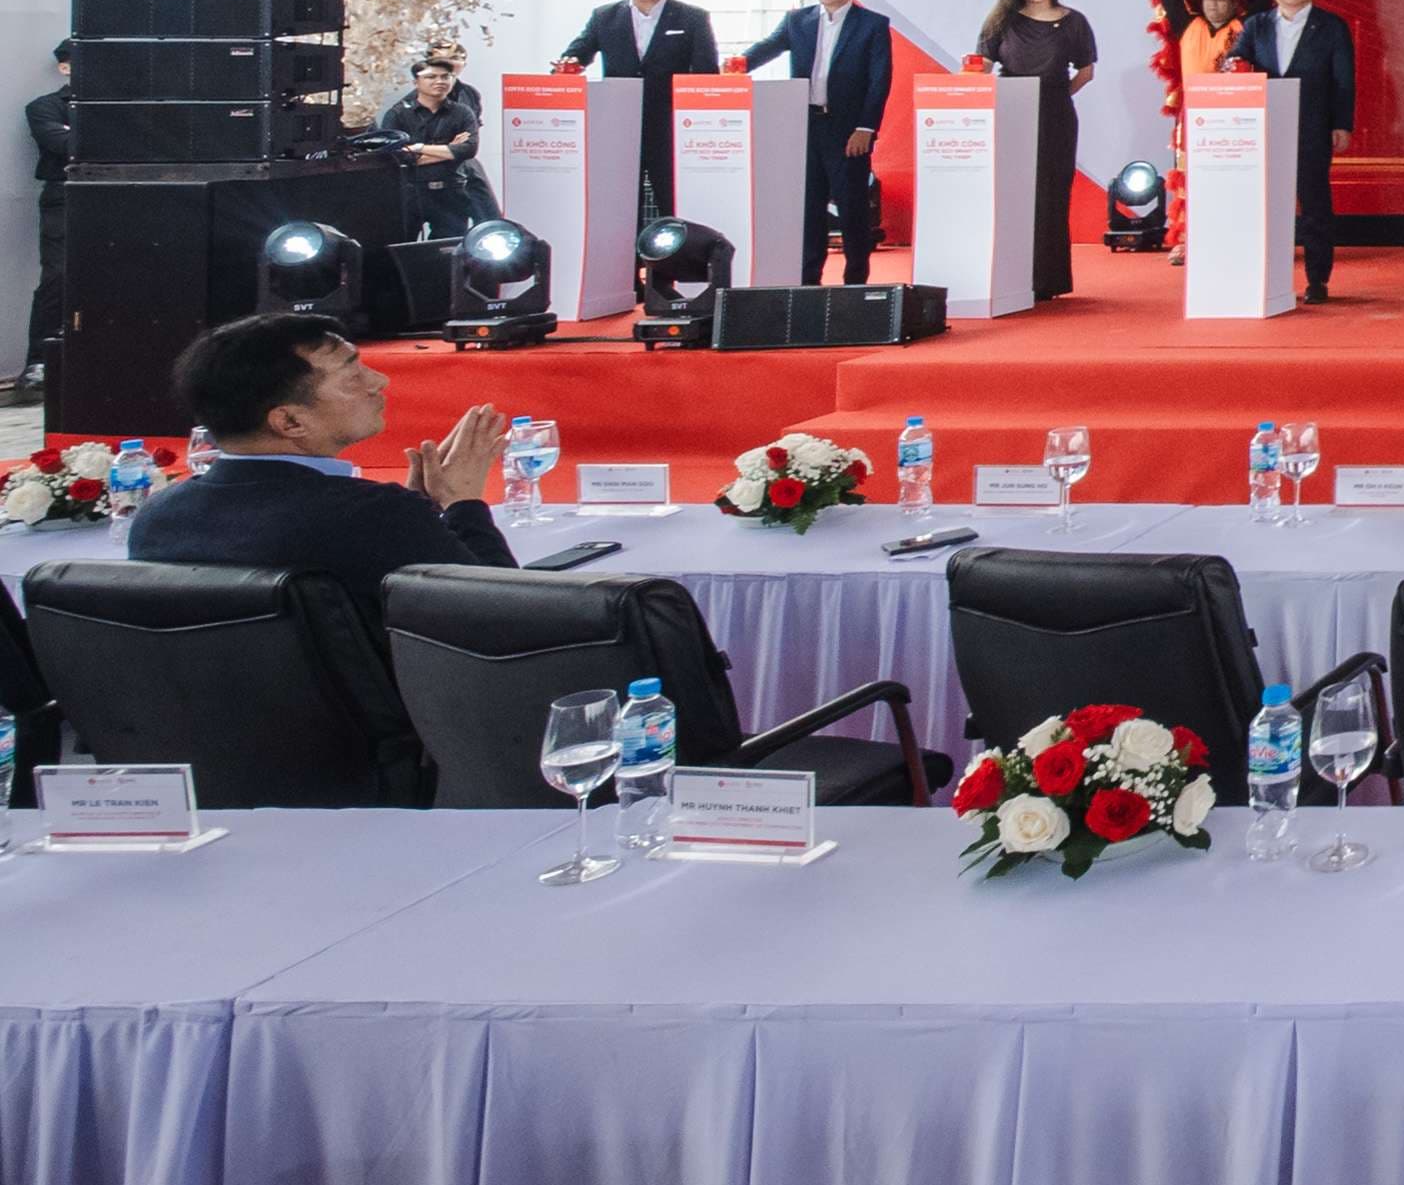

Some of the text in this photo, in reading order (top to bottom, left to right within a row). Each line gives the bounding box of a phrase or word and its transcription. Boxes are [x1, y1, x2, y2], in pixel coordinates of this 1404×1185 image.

[293, 303, 314, 312] SVT
[487, 302, 507, 310] SVT
[671, 302, 688, 310] SVT
[697, 803, 733, 812] HUYNH
[735, 804, 770, 813] THANH
